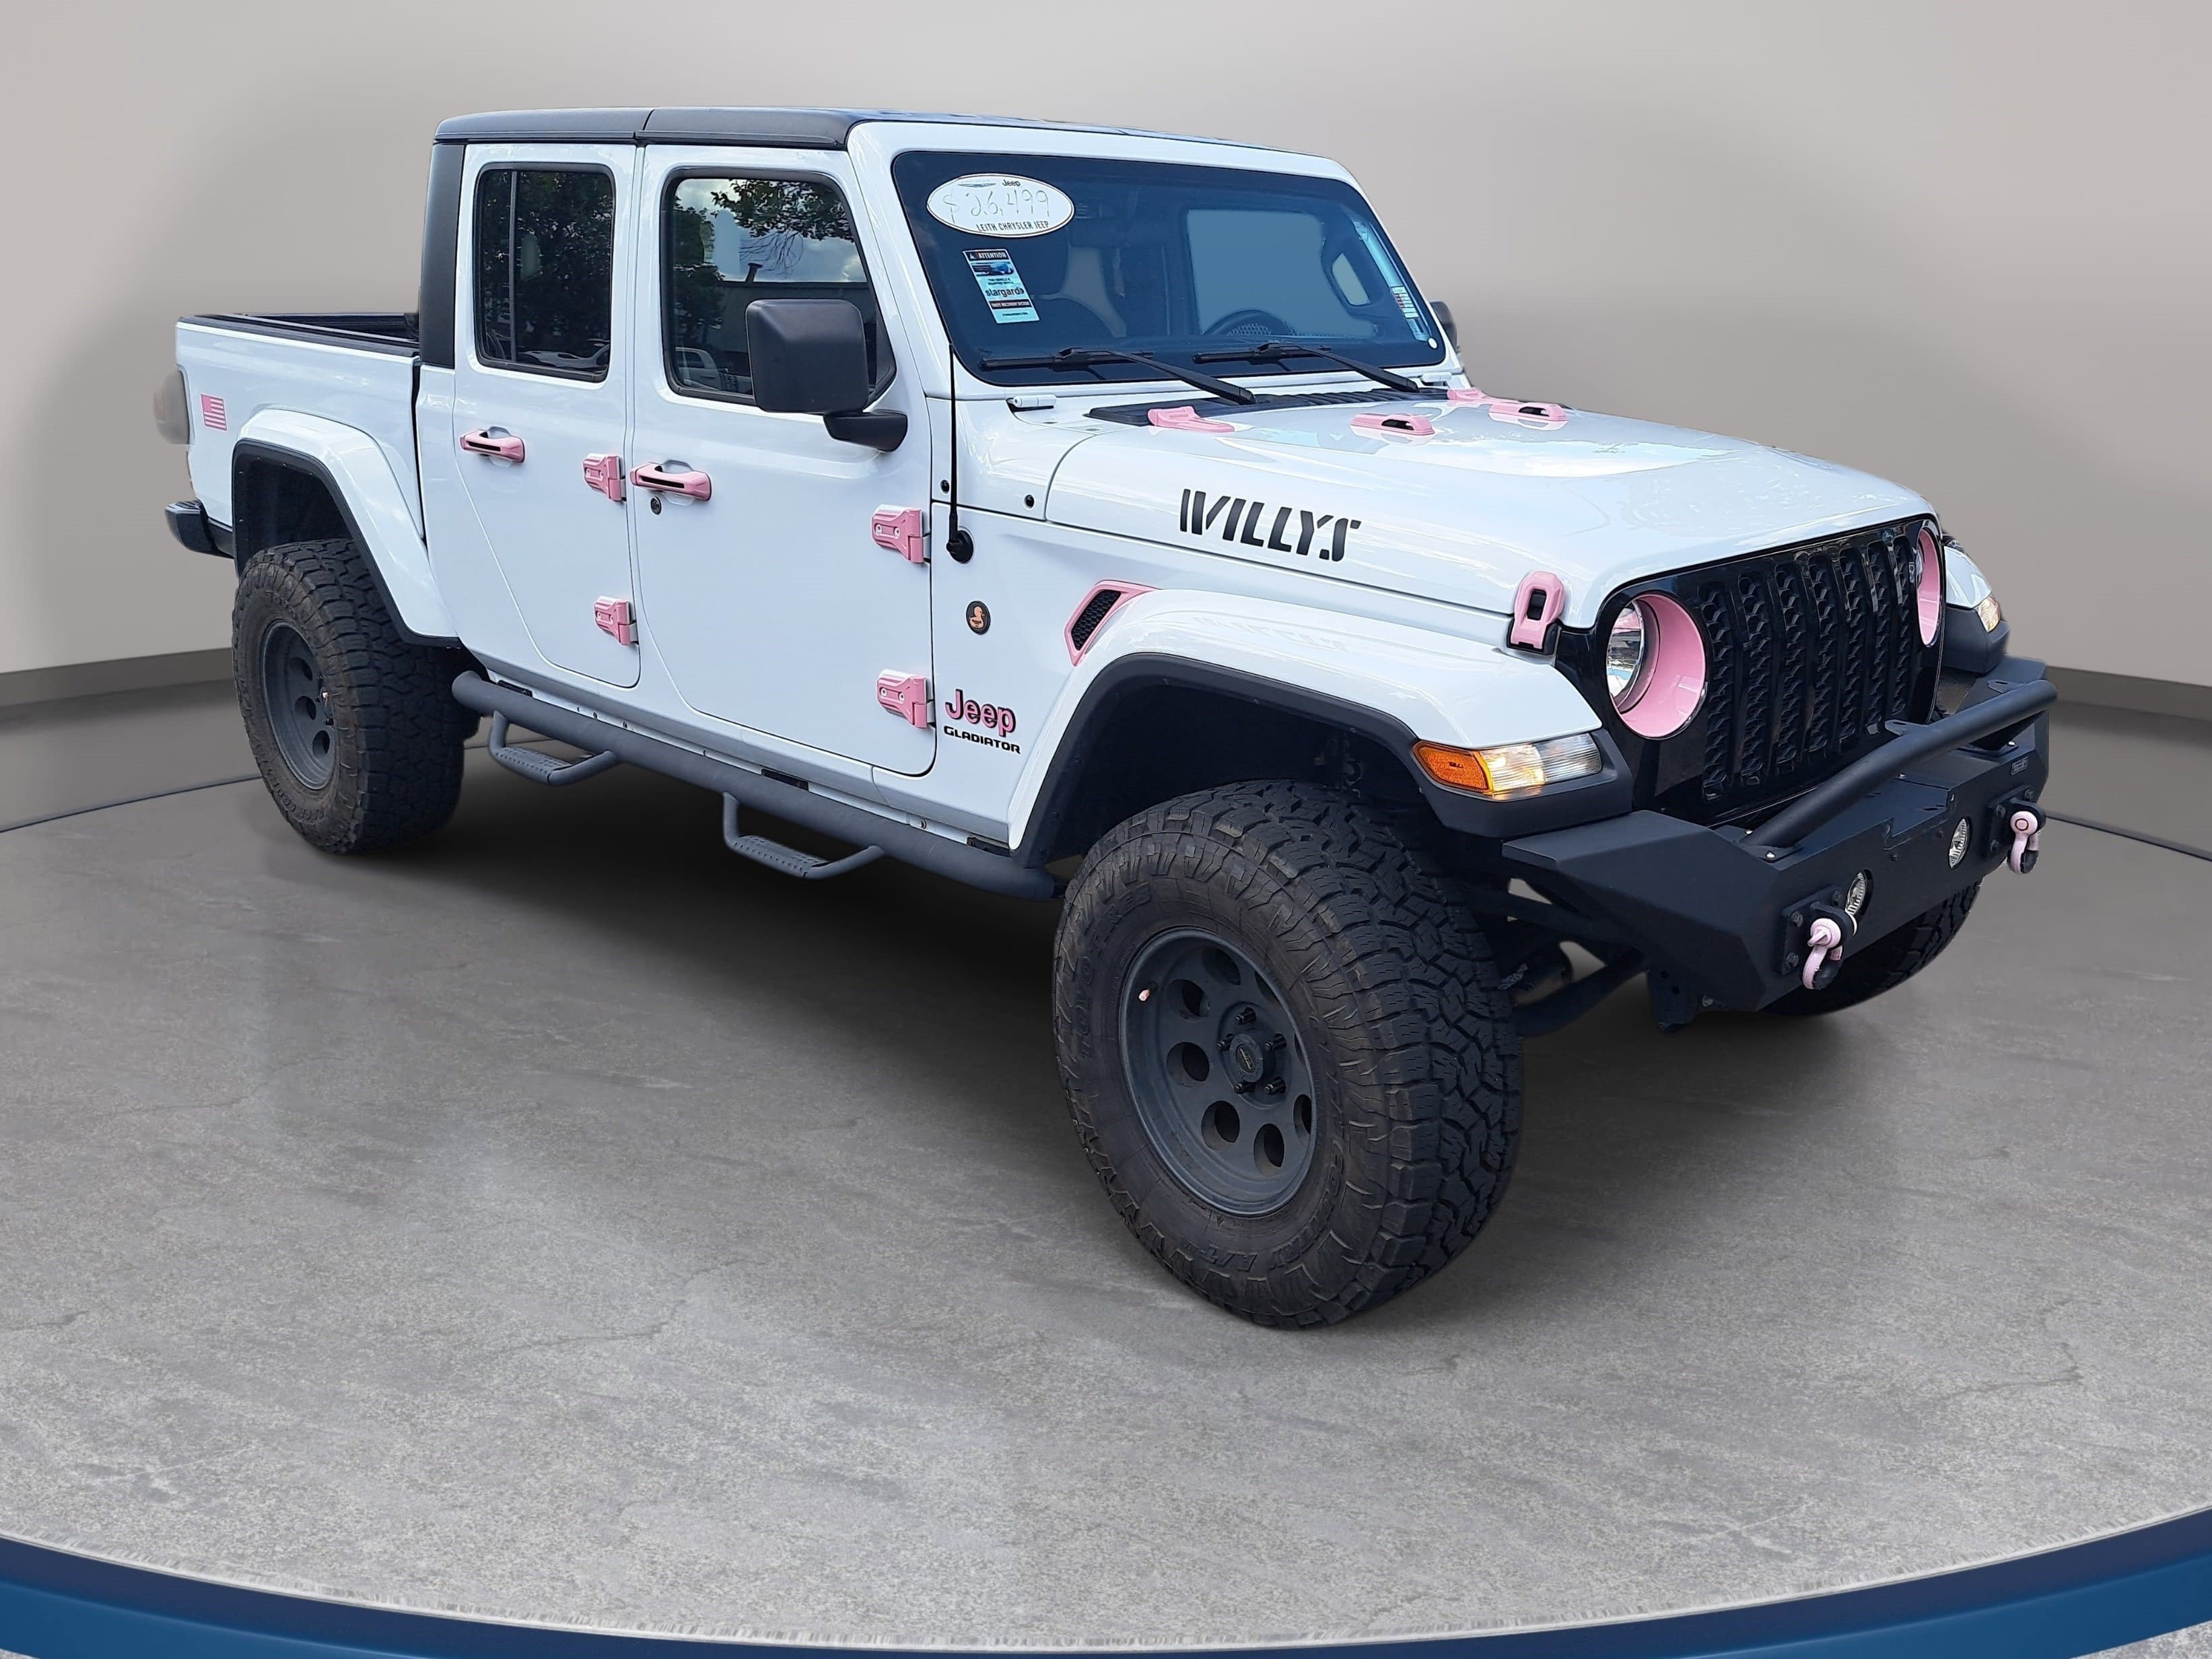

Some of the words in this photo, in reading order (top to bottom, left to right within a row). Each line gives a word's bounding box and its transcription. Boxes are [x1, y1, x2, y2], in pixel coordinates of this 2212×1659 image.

[1002, 179, 1021, 187] Jeep
[976, 223, 998, 232] LEITH
[999, 222, 1033, 231] CHRYSLER
[1034, 220, 1050, 229] JEEP
[1180, 488, 1362, 562] WILLYS
[944, 688, 1016, 738] Jeep
[943, 725, 1021, 755] GLADIATOR
